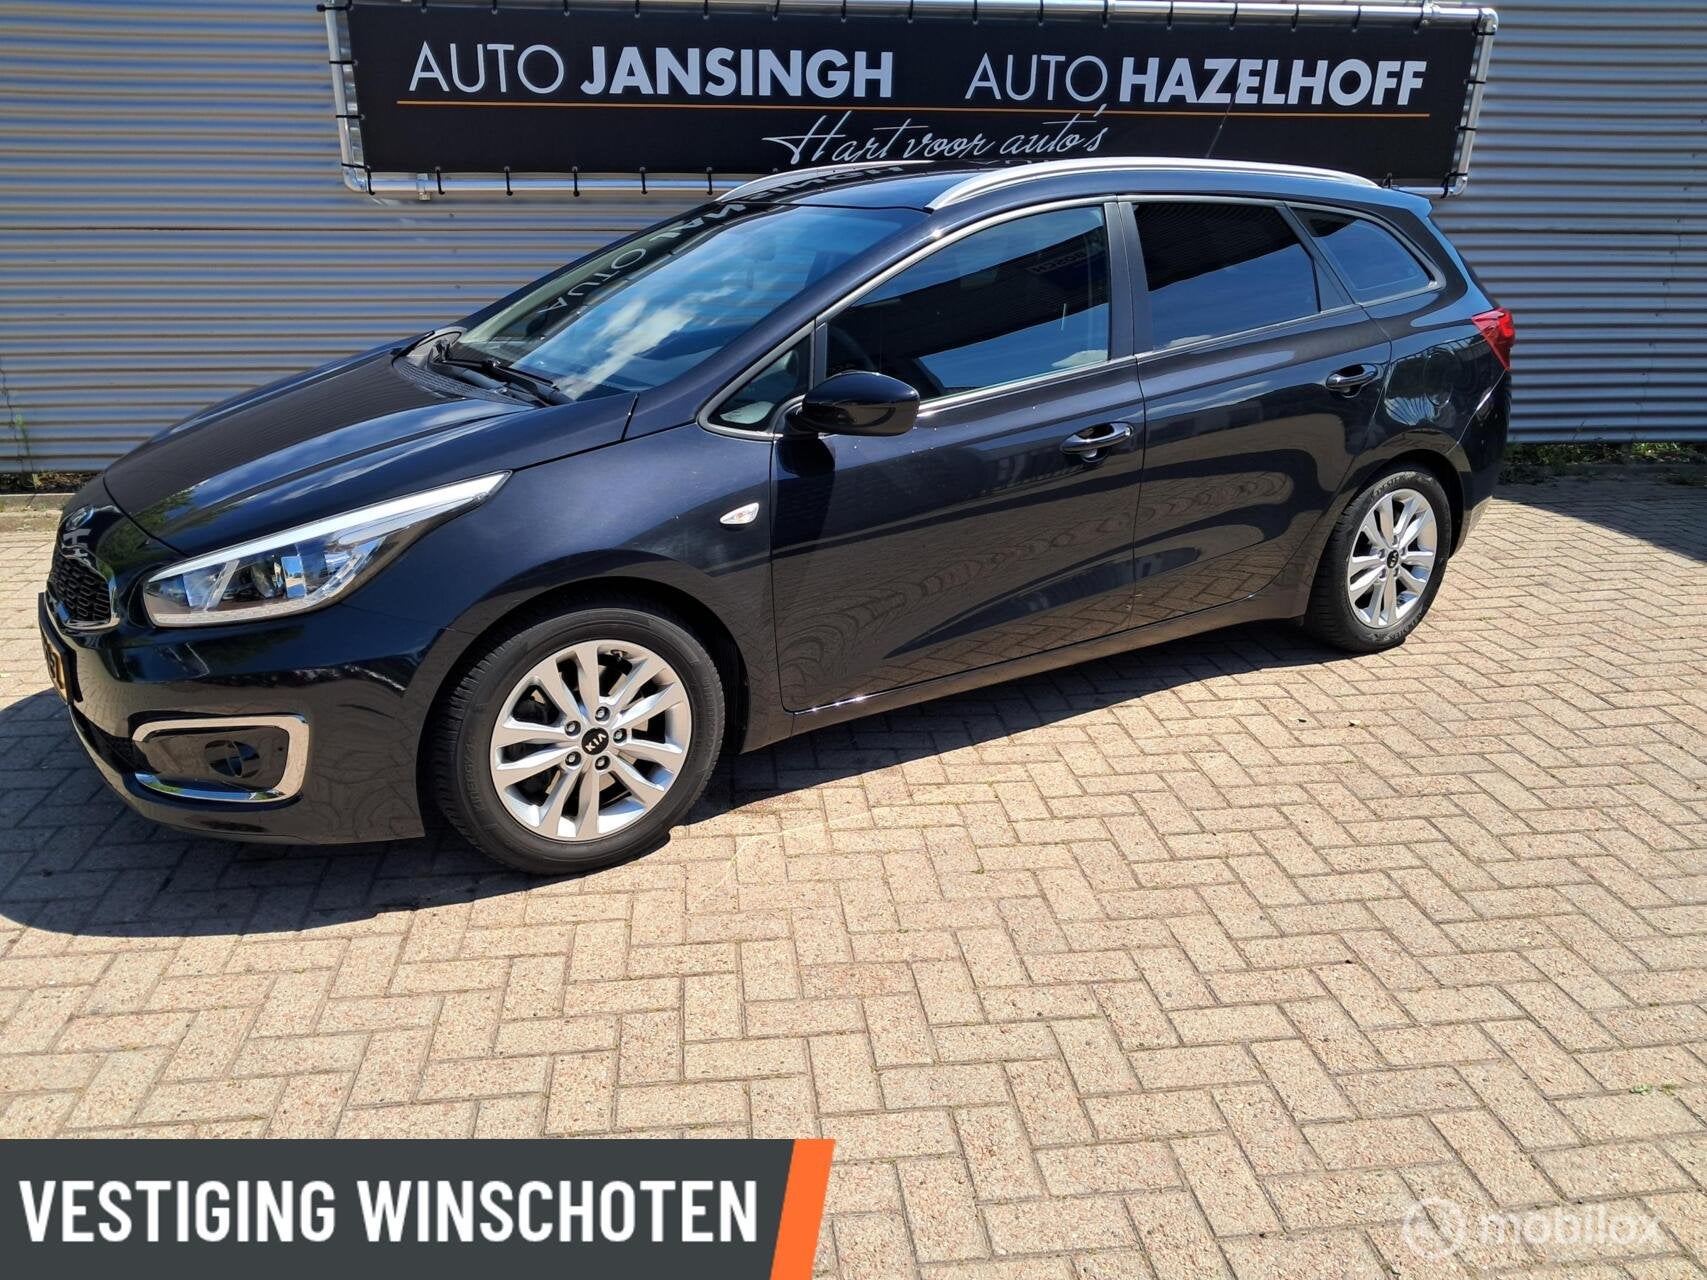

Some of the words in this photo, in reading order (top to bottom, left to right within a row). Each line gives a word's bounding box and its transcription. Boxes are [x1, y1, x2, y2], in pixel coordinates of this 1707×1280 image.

[408, 41, 565, 94] AUTO
[580, 46, 893, 98] JANSINGH
[965, 52, 1108, 102] AUTO
[1119, 56, 1428, 106] HAZELHOFF
[761, 110, 929, 165] Hart
[901, 132, 996, 160] voor
[585, 733, 607, 752] KIA
